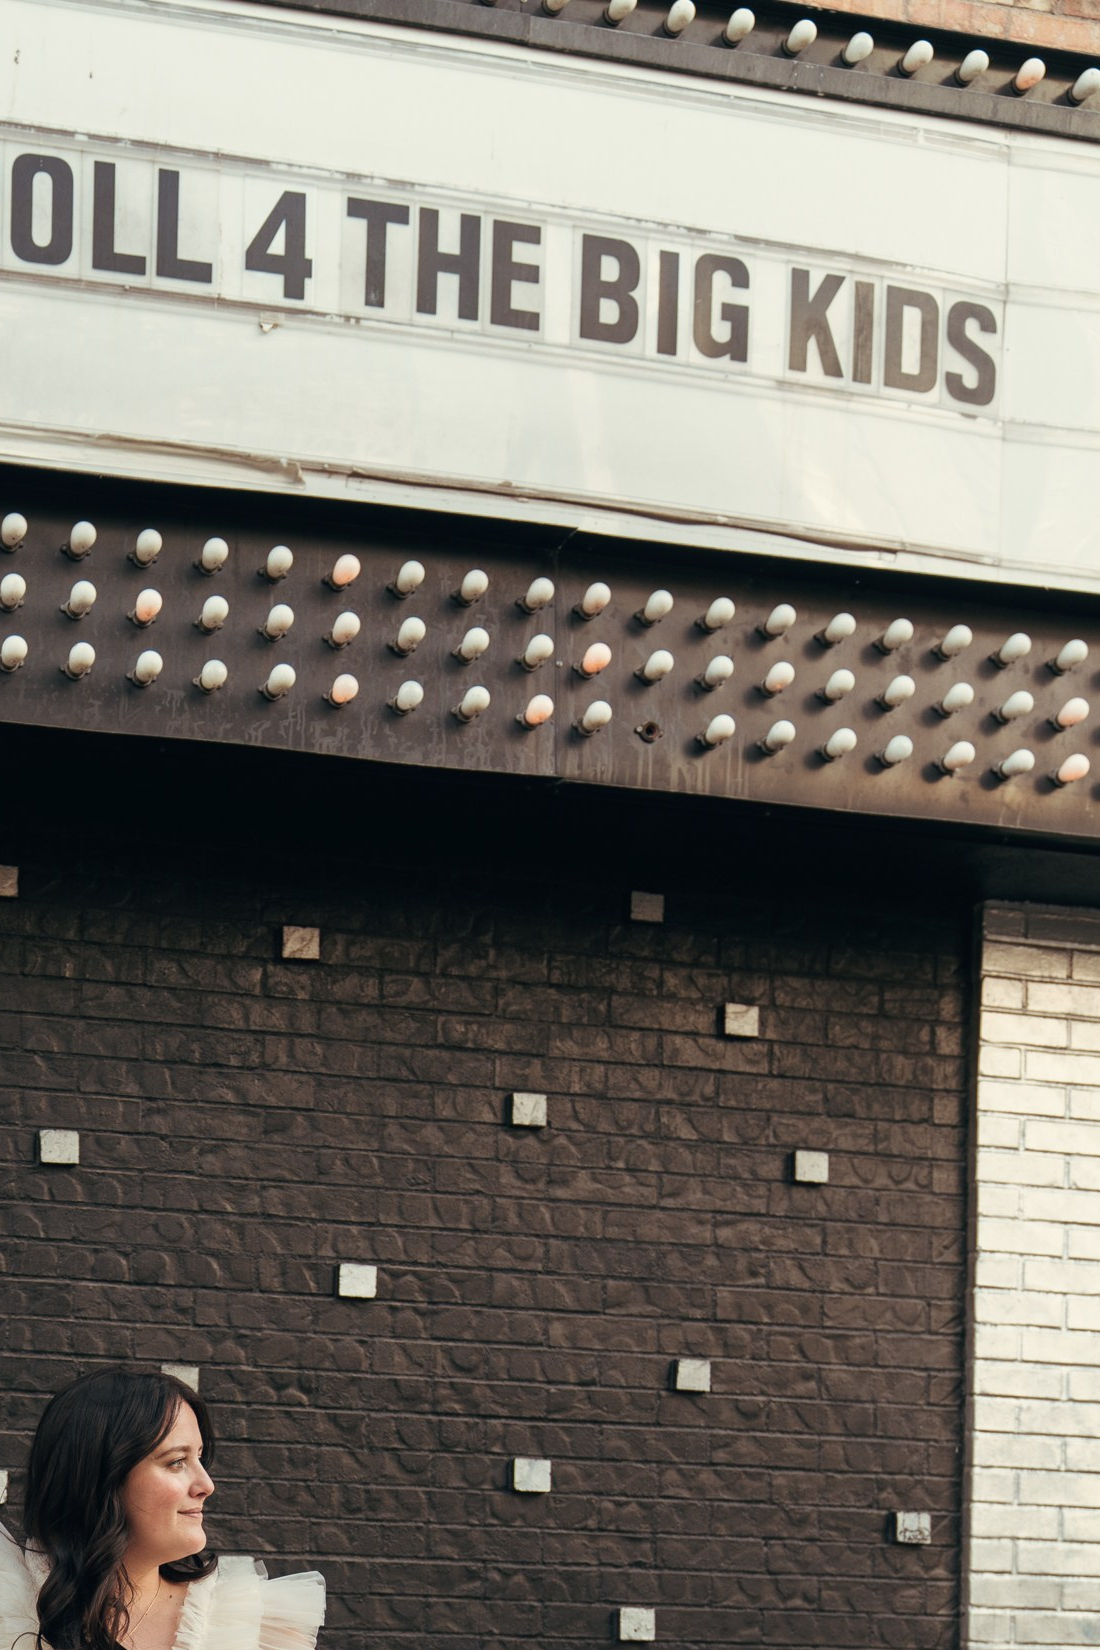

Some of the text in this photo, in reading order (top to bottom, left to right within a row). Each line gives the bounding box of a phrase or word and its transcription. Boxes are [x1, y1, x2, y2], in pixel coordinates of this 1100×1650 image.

[245, 190, 313, 301] 4
[346, 196, 543, 331] THE
[579, 234, 750, 364] BIG
[788, 267, 998, 407] KIDS
